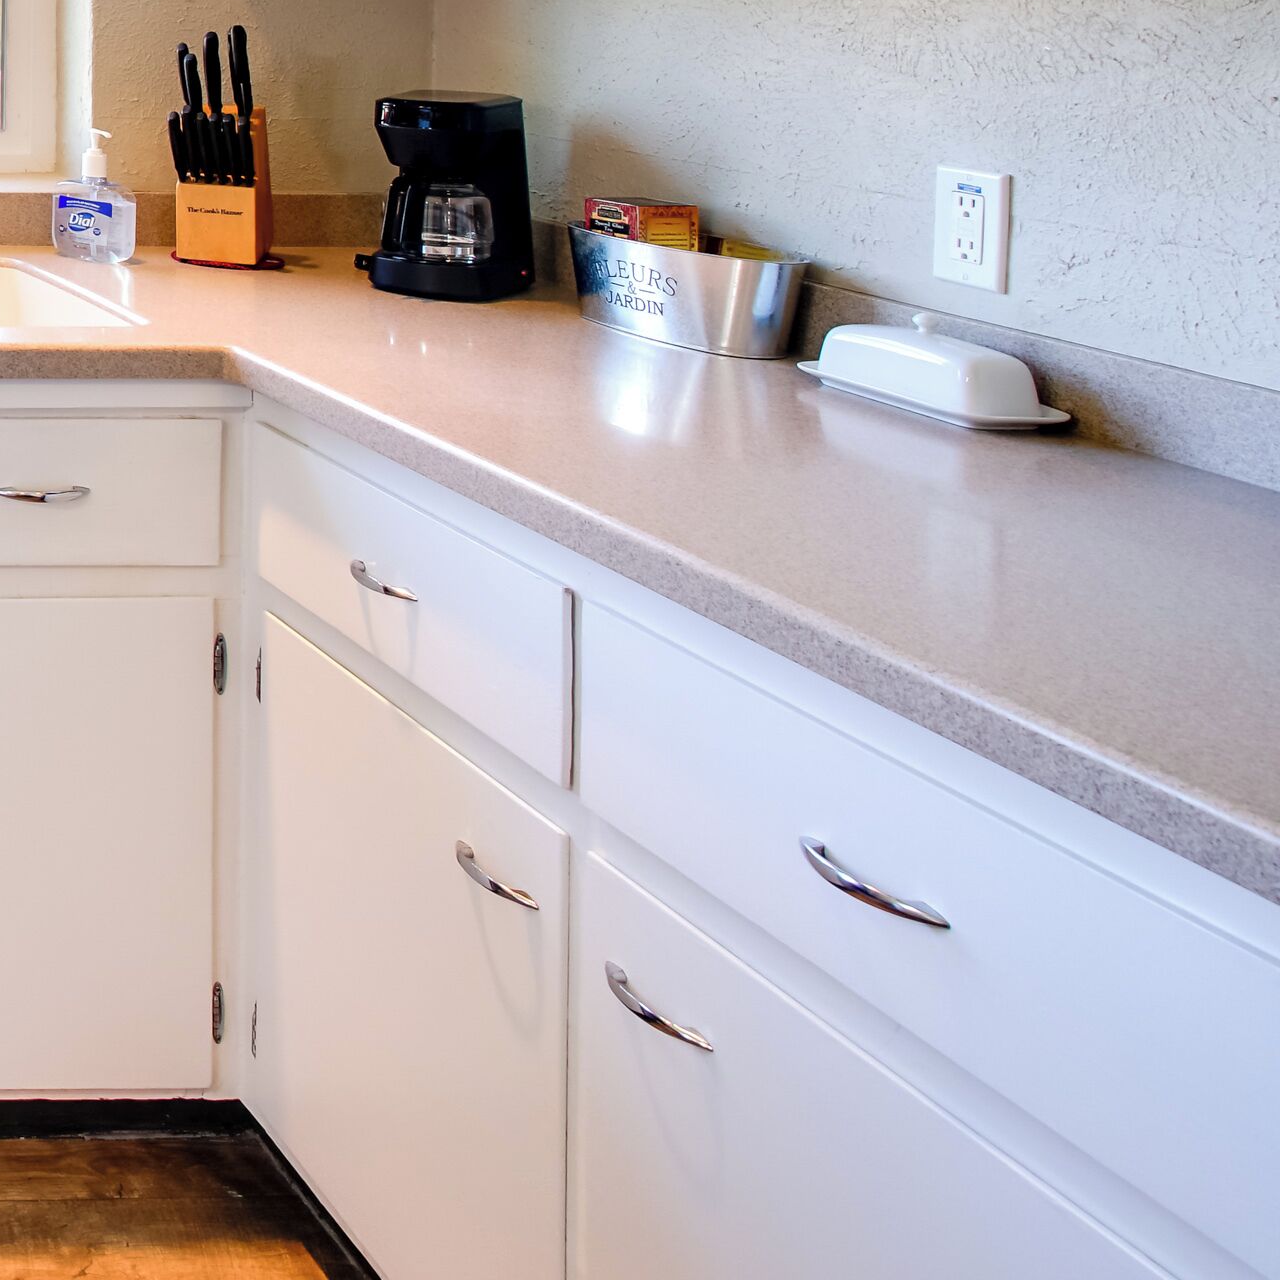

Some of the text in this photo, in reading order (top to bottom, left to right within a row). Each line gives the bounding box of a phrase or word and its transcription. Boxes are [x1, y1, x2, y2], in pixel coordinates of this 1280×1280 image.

[69, 213, 96, 228] Dial
[595, 259, 678, 297] FLEURS
[627, 280, 637, 295] &
[605, 290, 665, 317] JARDIN
